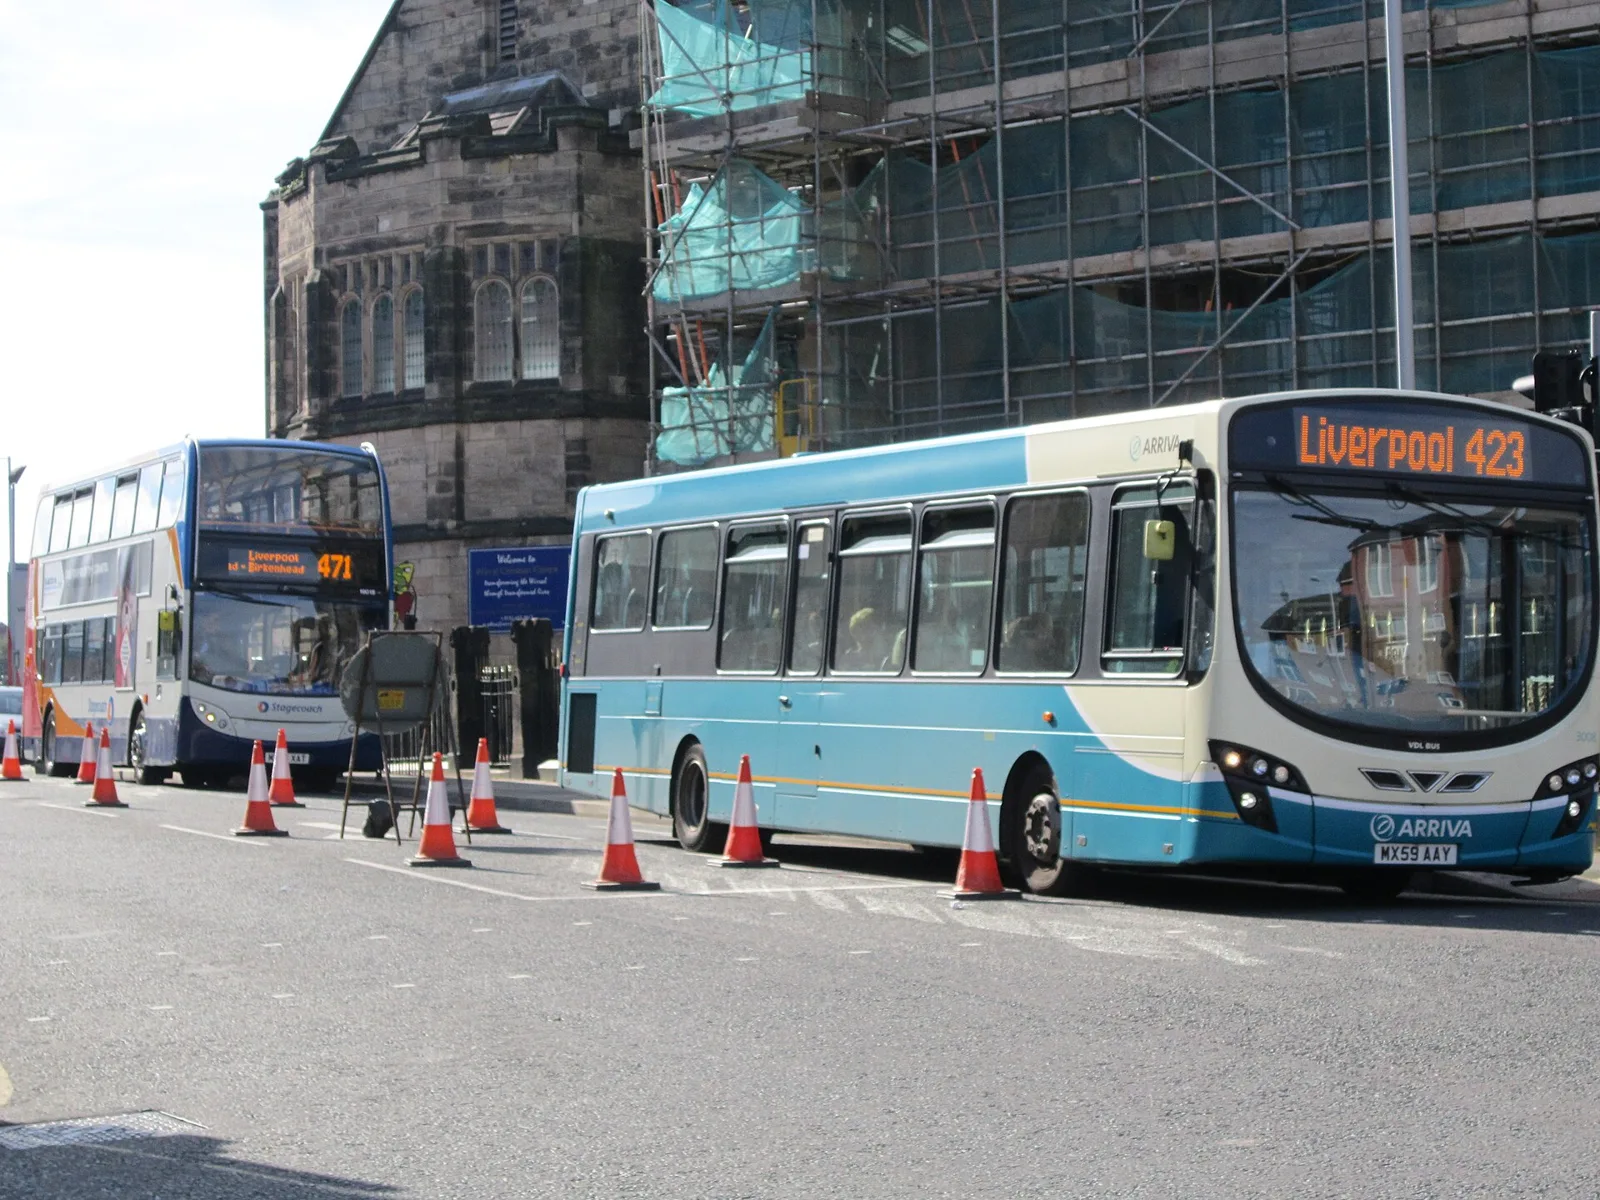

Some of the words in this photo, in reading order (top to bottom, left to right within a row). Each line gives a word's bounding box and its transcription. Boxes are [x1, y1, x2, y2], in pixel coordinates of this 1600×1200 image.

[1142, 434, 1180, 455] ARRIVA
[1300, 415, 1454, 473] Liverpool
[1465, 427, 1525, 478] 423
[248, 549, 299, 563] Liverpool
[497, 554, 526, 564] Welcome
[528, 555, 536, 563] to
[248, 561, 305, 575] Birkenhead
[317, 553, 352, 580] 471
[272, 702, 323, 714] Stagecoach
[1408, 741, 1424, 749] VDL
[1425, 742, 1440, 750] BUS
[1398, 819, 1472, 837] ARRIVA
[1380, 846, 1418, 862] MX59
[1423, 846, 1451, 862] AAY
